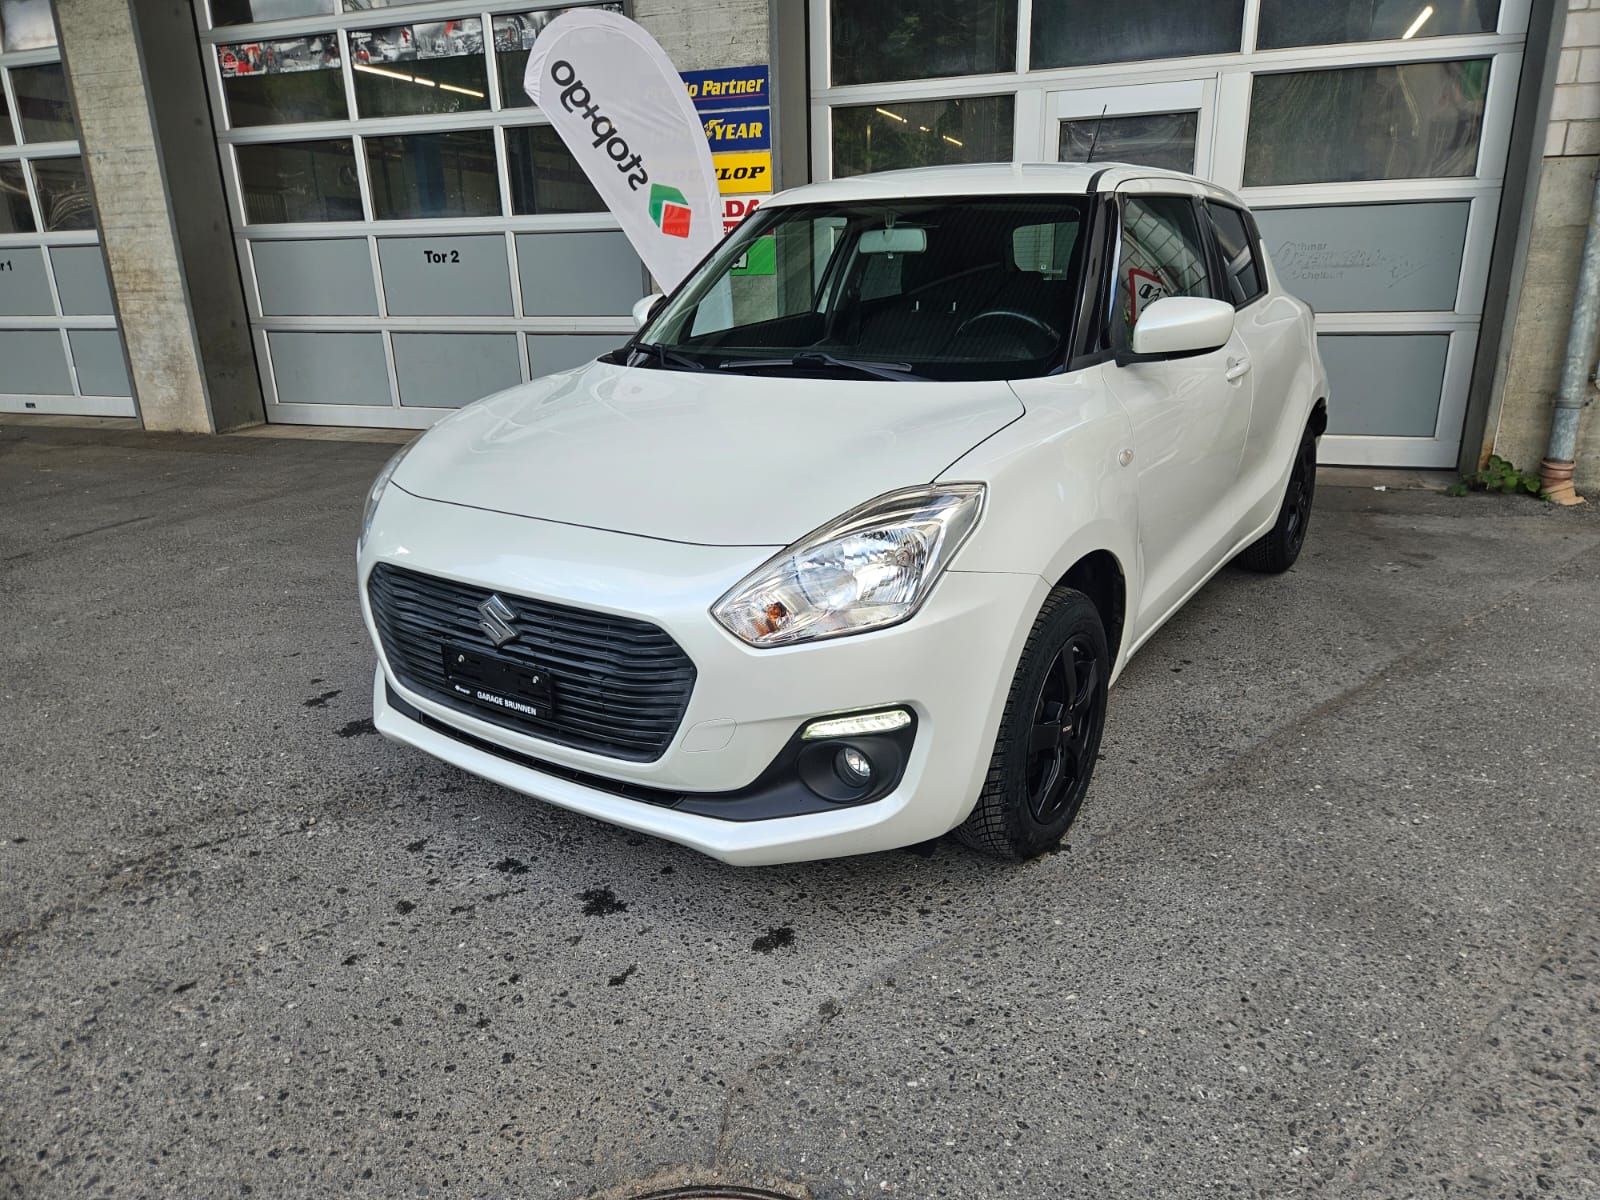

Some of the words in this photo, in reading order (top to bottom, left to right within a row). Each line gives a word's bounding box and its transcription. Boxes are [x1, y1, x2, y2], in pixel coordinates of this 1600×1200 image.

[702, 79, 765, 96] Partner
[722, 199, 760, 217] DA
[424, 250, 447, 263] Tor
[450, 250, 460, 263] 2
[7, 260, 12, 271] 1
[477, 691, 504, 706] GARAGE
[504, 699, 537, 716] BRUNNEN
